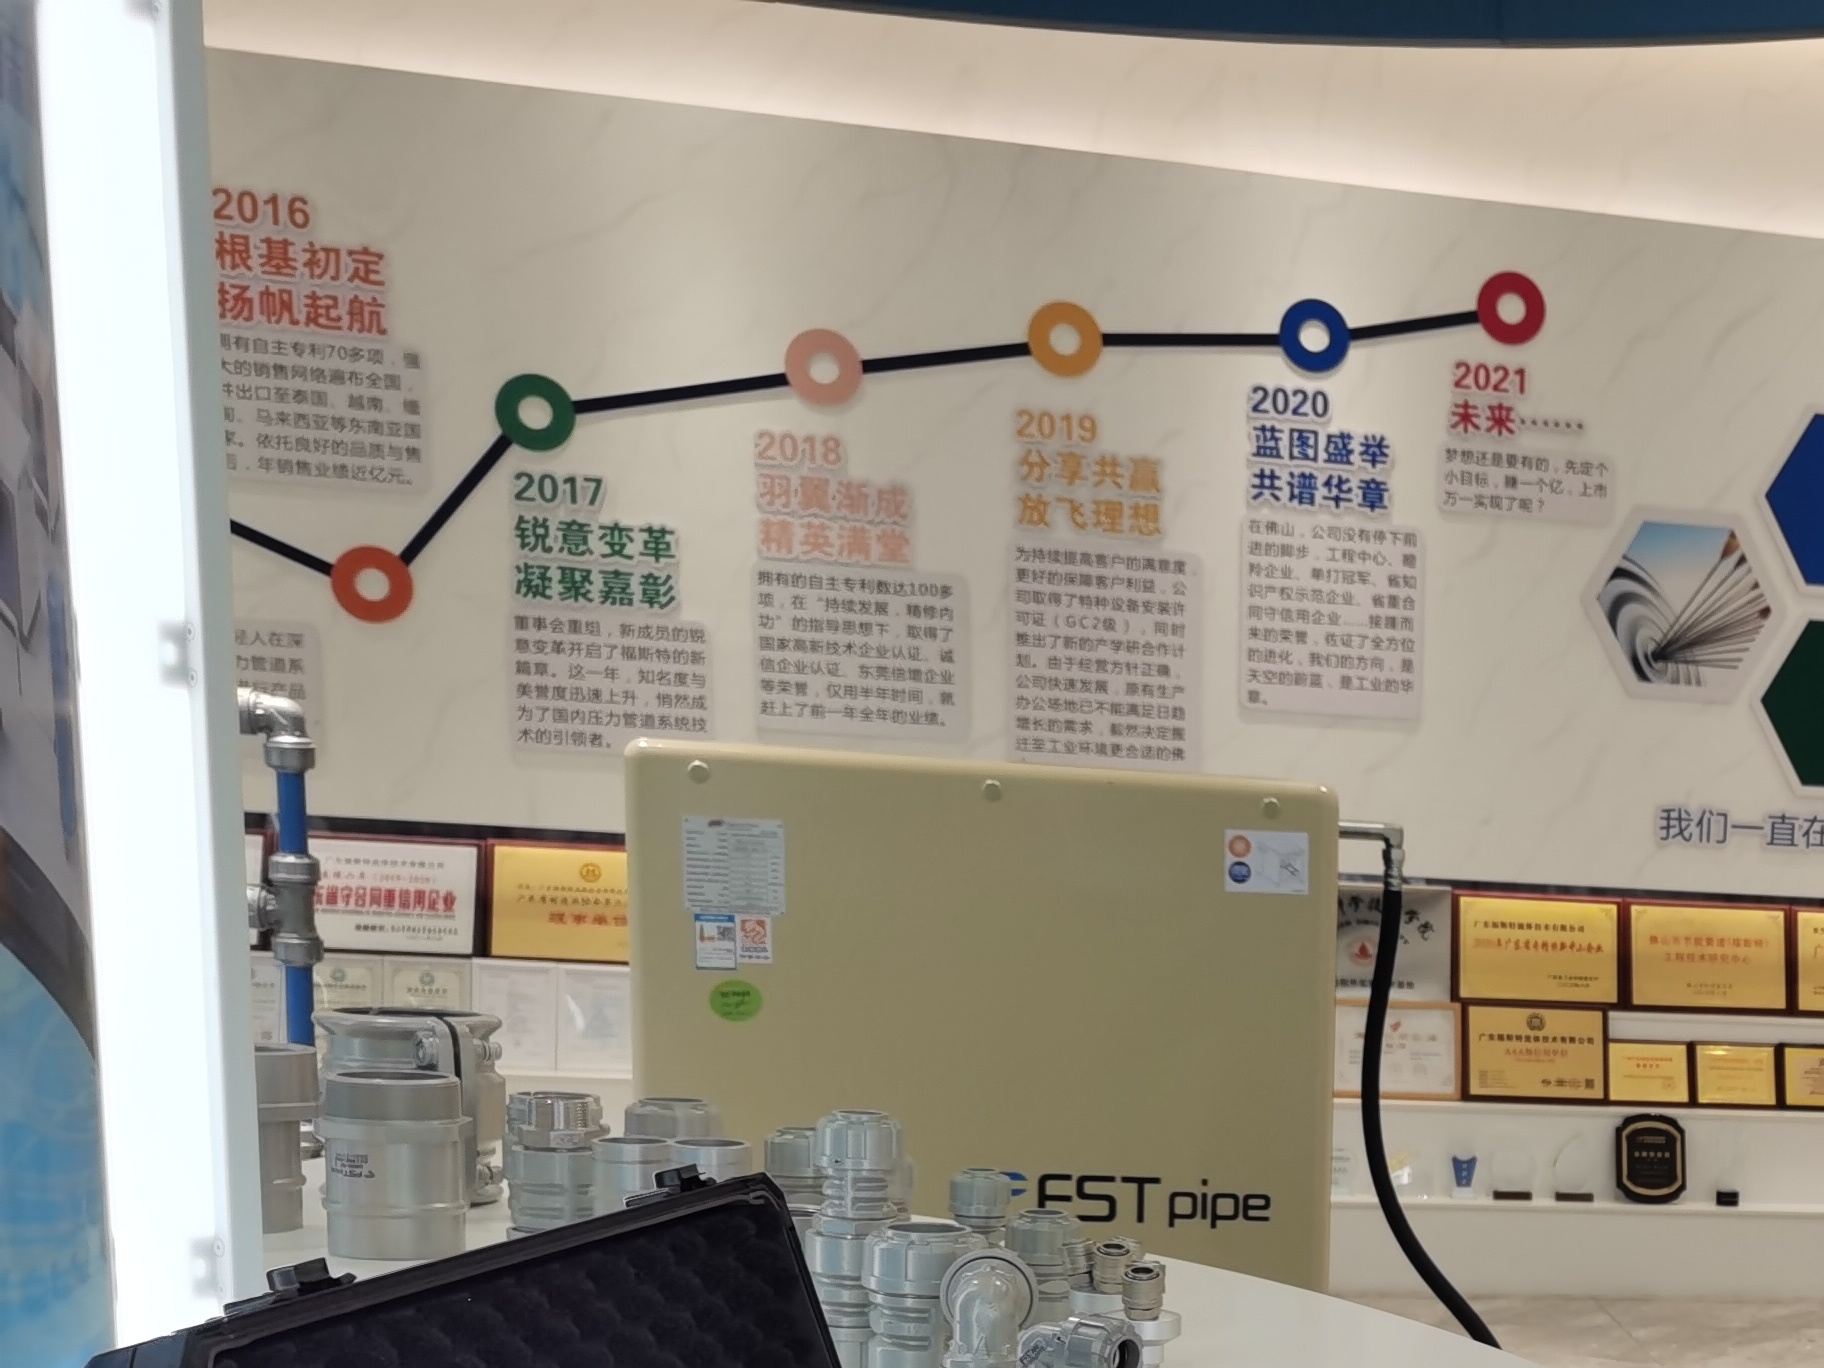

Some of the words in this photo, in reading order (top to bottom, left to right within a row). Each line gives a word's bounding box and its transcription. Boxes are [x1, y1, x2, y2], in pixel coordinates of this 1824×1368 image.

[212, 187, 311, 230] 2016
[215, 231, 386, 287] 根基初定
[217, 282, 388, 336] 扬帆起航
[1454, 361, 1527, 395] 2021
[1251, 386, 1330, 418] 2020
[1015, 408, 1098, 443] 2019
[1251, 423, 1390, 469] 蓝图盛举
[757, 430, 842, 466] 2018
[513, 471, 605, 507] 2017
[1251, 468, 1389, 513] 共谱华章
[1018, 493, 1163, 537] 放飞理想
[514, 514, 676, 564] 锐意变革
[514, 561, 676, 610] 凝聚嘉彰
[1037, 1173, 1162, 1224] FST
[1167, 1177, 1272, 1229] pipe
